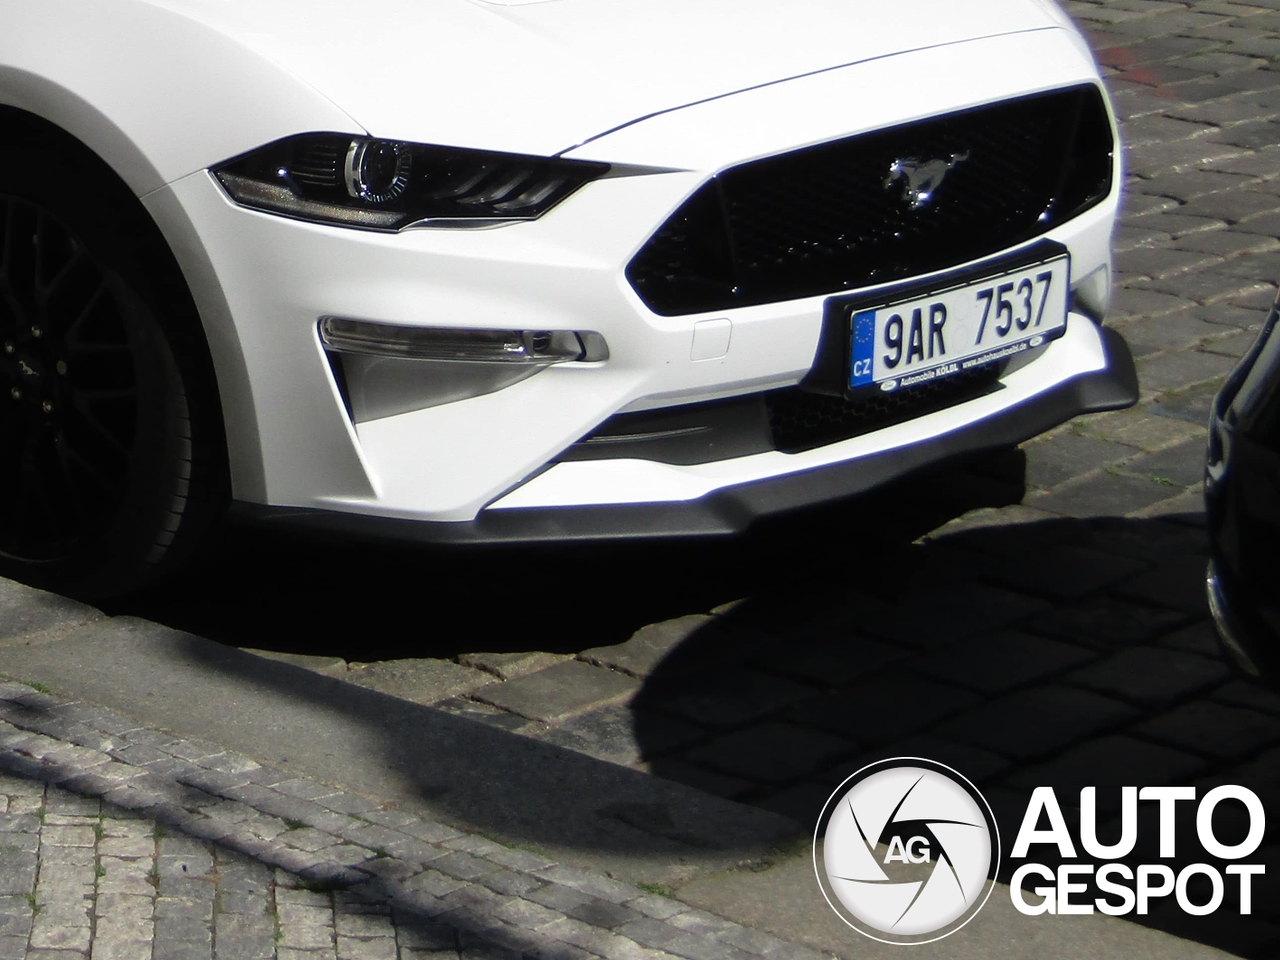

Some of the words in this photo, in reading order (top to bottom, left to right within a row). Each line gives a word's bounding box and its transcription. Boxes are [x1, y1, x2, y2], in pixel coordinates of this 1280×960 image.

[883, 302, 947, 369] 9AR
[974, 270, 1053, 346] 7537
[853, 357, 871, 377] CZ
[900, 370, 935, 387] Automobile
